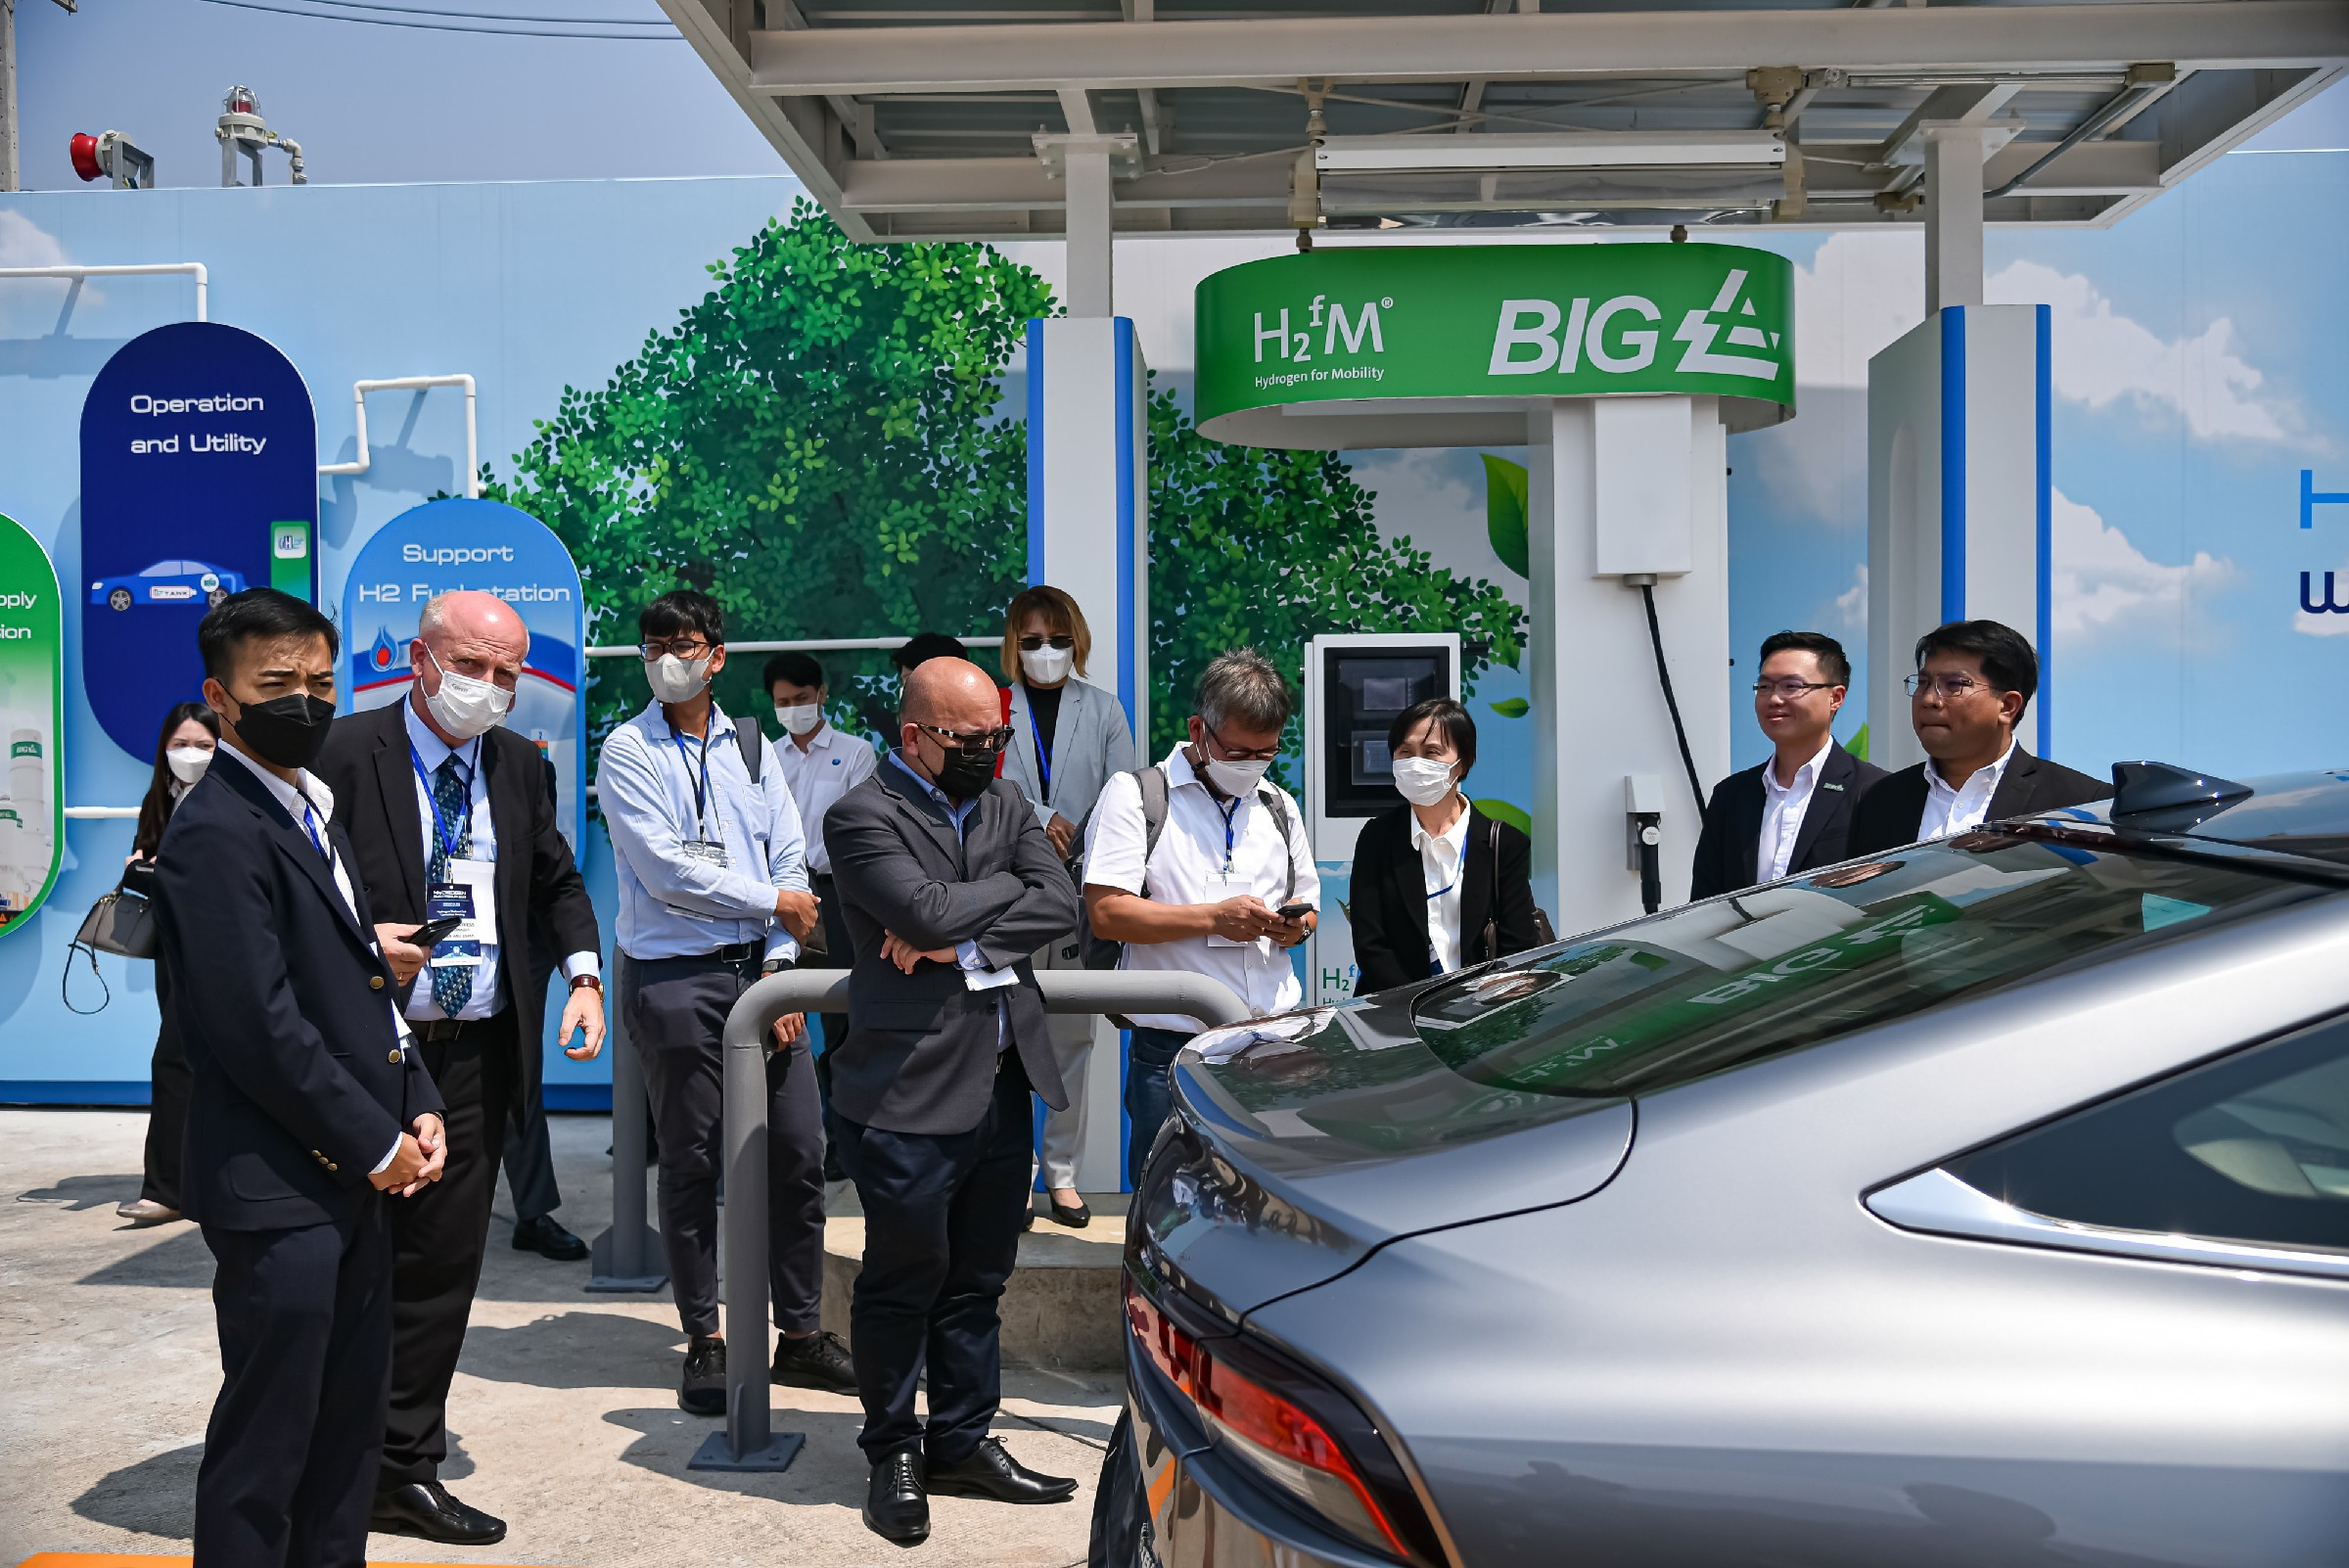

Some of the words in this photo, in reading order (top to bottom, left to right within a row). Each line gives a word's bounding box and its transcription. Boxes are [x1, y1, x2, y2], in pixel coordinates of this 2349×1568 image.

[1487, 295, 1662, 375] BIG
[1255, 372, 1308, 390] Hydrogen
[1311, 368, 1328, 382] for
[1331, 366, 1385, 382] Mobility
[130, 392, 264, 417] Operation
[130, 434, 179, 453] and
[190, 434, 267, 455] Utility
[402, 544, 514, 566] Support
[359, 584, 401, 603] H2
[478, 583, 571, 603] tation
[0, 623, 32, 639] ion
